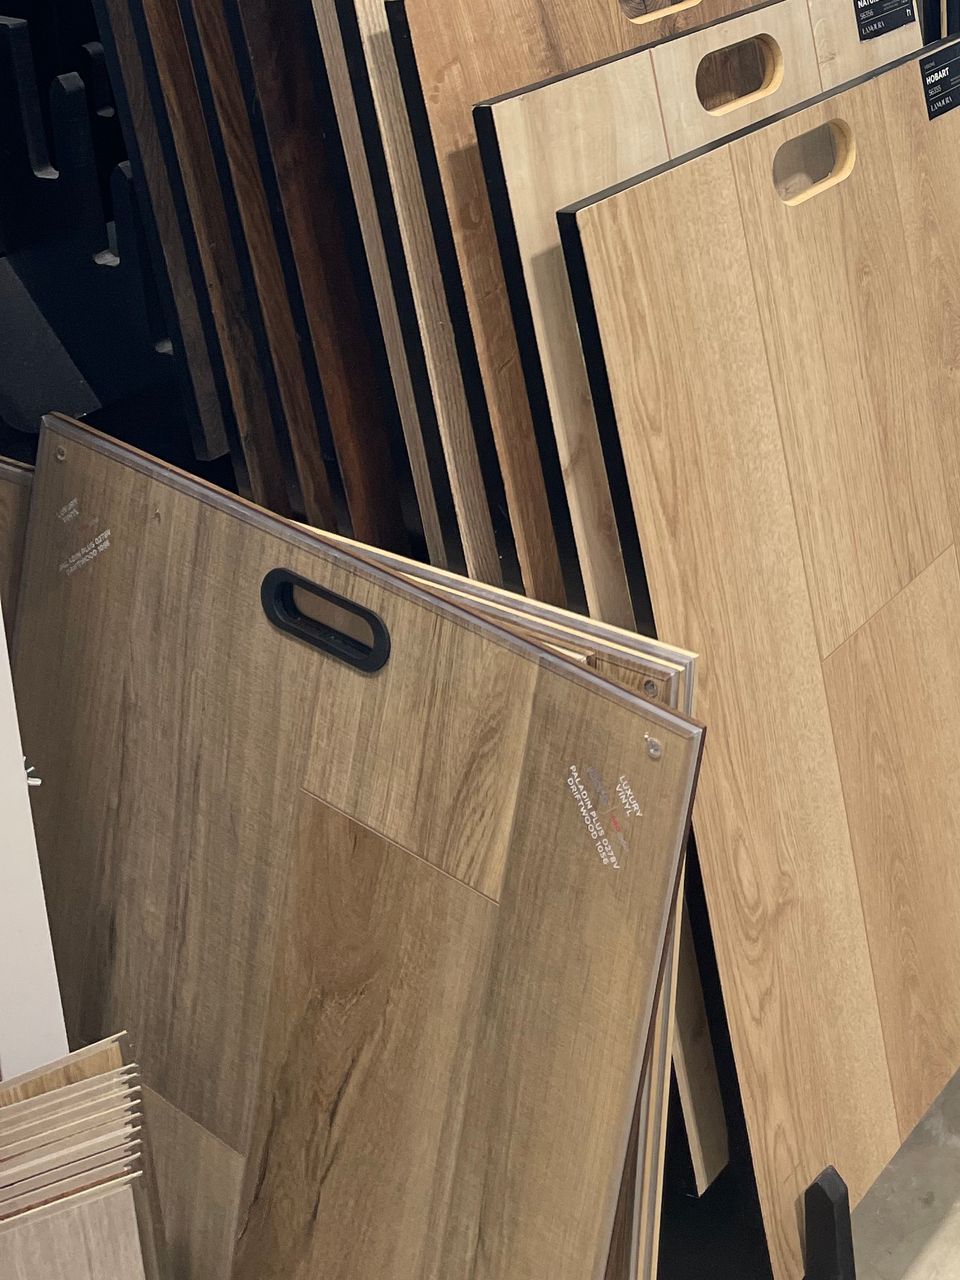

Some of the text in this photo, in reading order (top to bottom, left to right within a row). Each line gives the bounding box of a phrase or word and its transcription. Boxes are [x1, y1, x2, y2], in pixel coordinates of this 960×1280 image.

[926, 66, 950, 86] HOBART
[570, 765, 593, 812] PALADIN
[590, 811, 604, 837] PLUS
[602, 838, 620, 869] 0278V
[616, 784, 633, 817] VINYL
[619, 775, 643, 817] LUXURY
[567, 778, 598, 839] DRIFTWOOD
[595, 841, 609, 865] 1056
